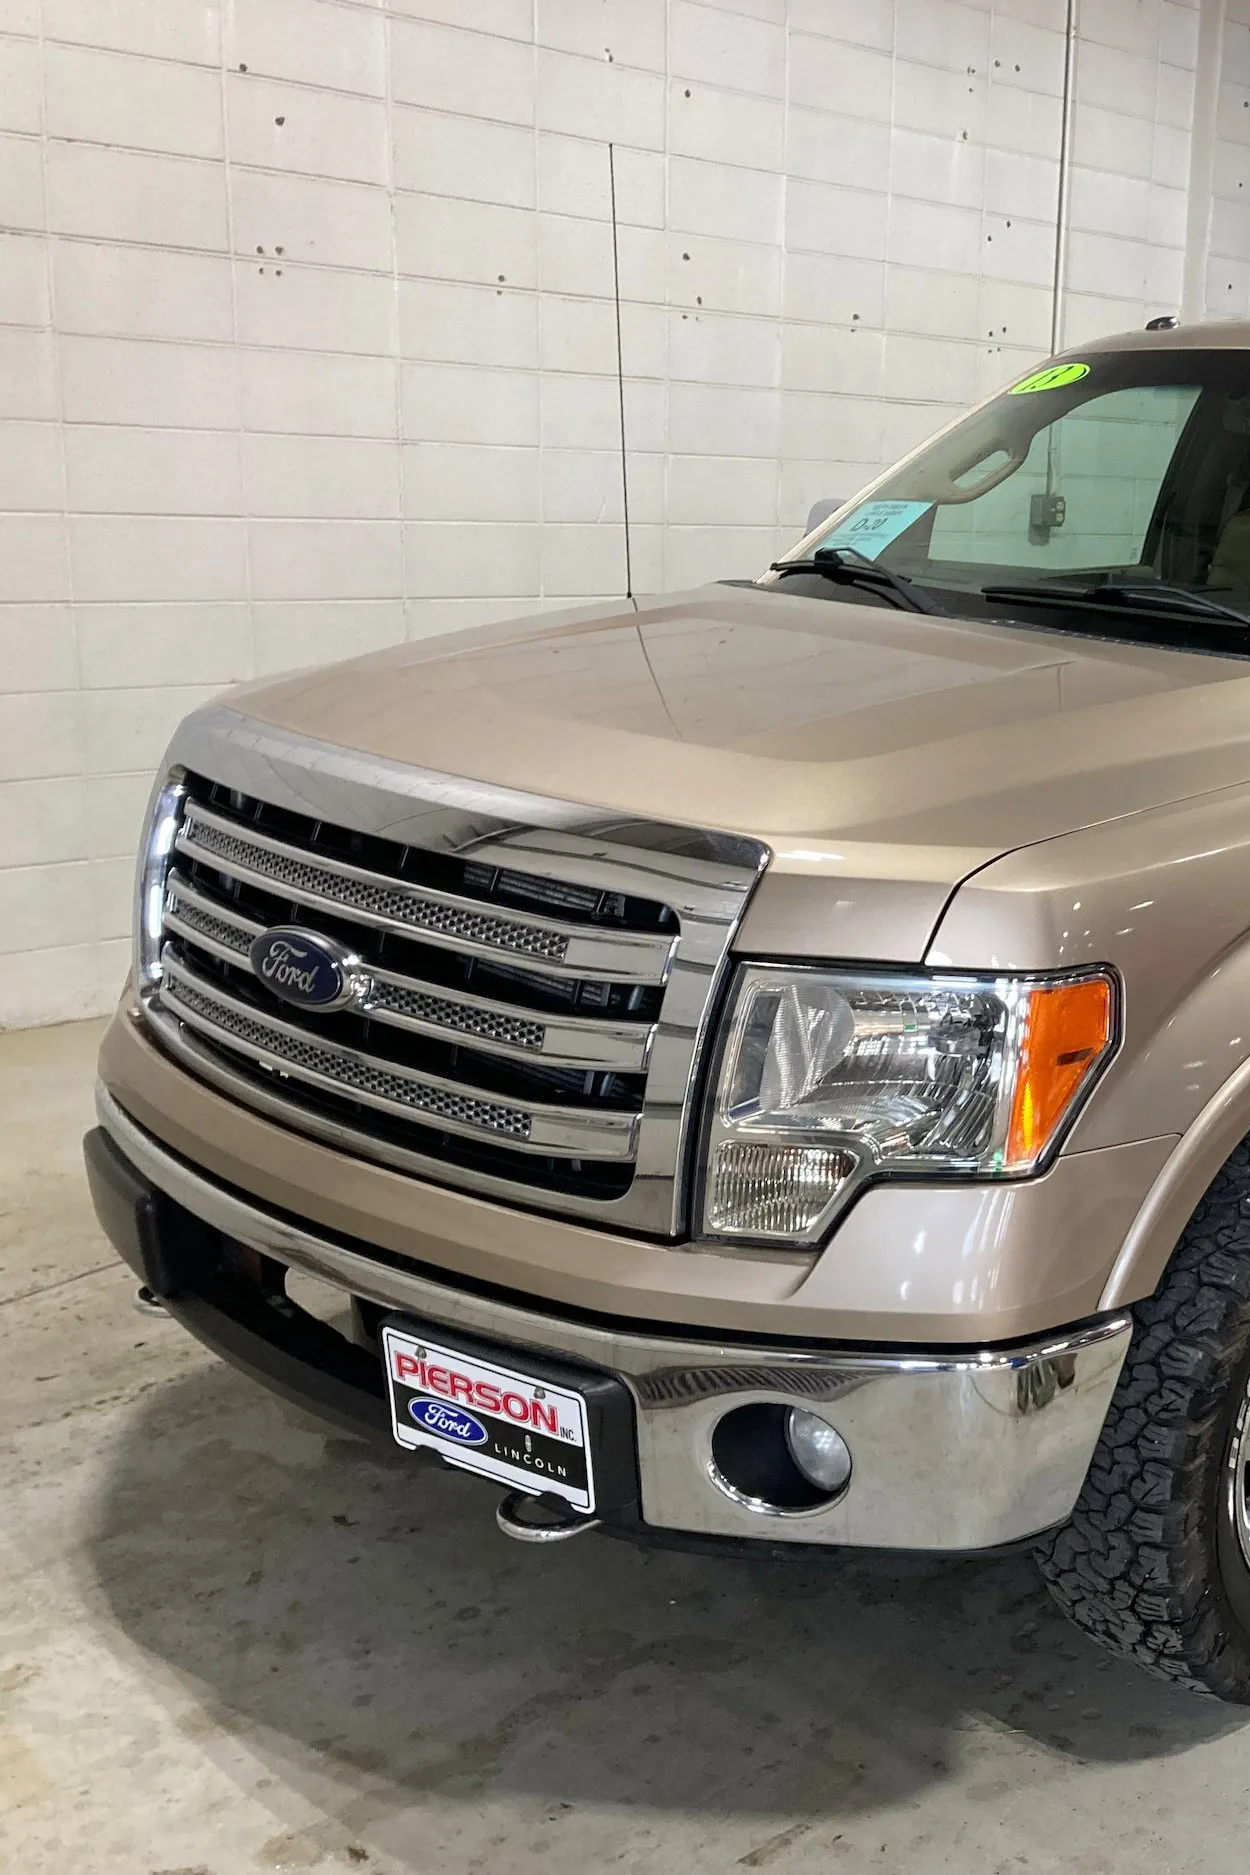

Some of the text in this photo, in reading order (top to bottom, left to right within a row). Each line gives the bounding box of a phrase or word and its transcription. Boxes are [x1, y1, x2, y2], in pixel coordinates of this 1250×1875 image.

[262, 940, 320, 993] Ford
[394, 1350, 577, 1443] PIERSON INC.
[424, 1403, 471, 1438] Ford
[494, 1442, 567, 1478] LINCOLN
